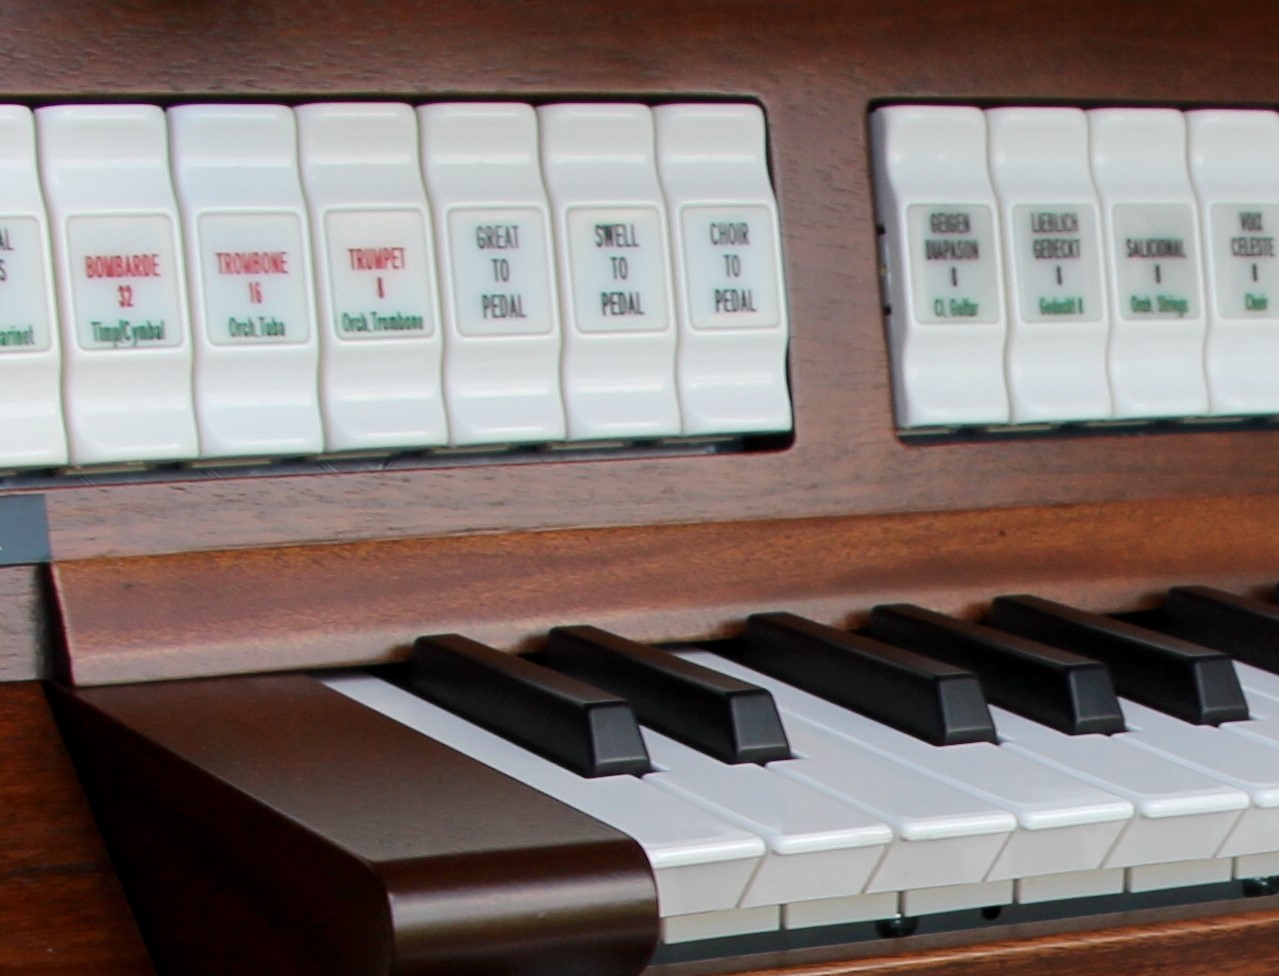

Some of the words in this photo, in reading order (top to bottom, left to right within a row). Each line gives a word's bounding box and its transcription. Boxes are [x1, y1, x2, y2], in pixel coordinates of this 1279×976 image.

[475, 225, 520, 250] GREAT
[594, 223, 640, 249] SWELL
[709, 222, 751, 246] CHOIR
[84, 254, 162, 279] BOMBARDE
[215, 251, 290, 276] TROMBONE
[347, 247, 407, 270] TRUMPET
[490, 258, 510, 282] TO
[609, 256, 629, 280] TO
[723, 254, 742, 278] TO
[117, 285, 135, 308] 32
[247, 282, 264, 304] 16
[600, 291, 645, 316] PEDAL
[714, 289, 757, 314] PEDAL
[481, 294, 527, 319] PEDAL
